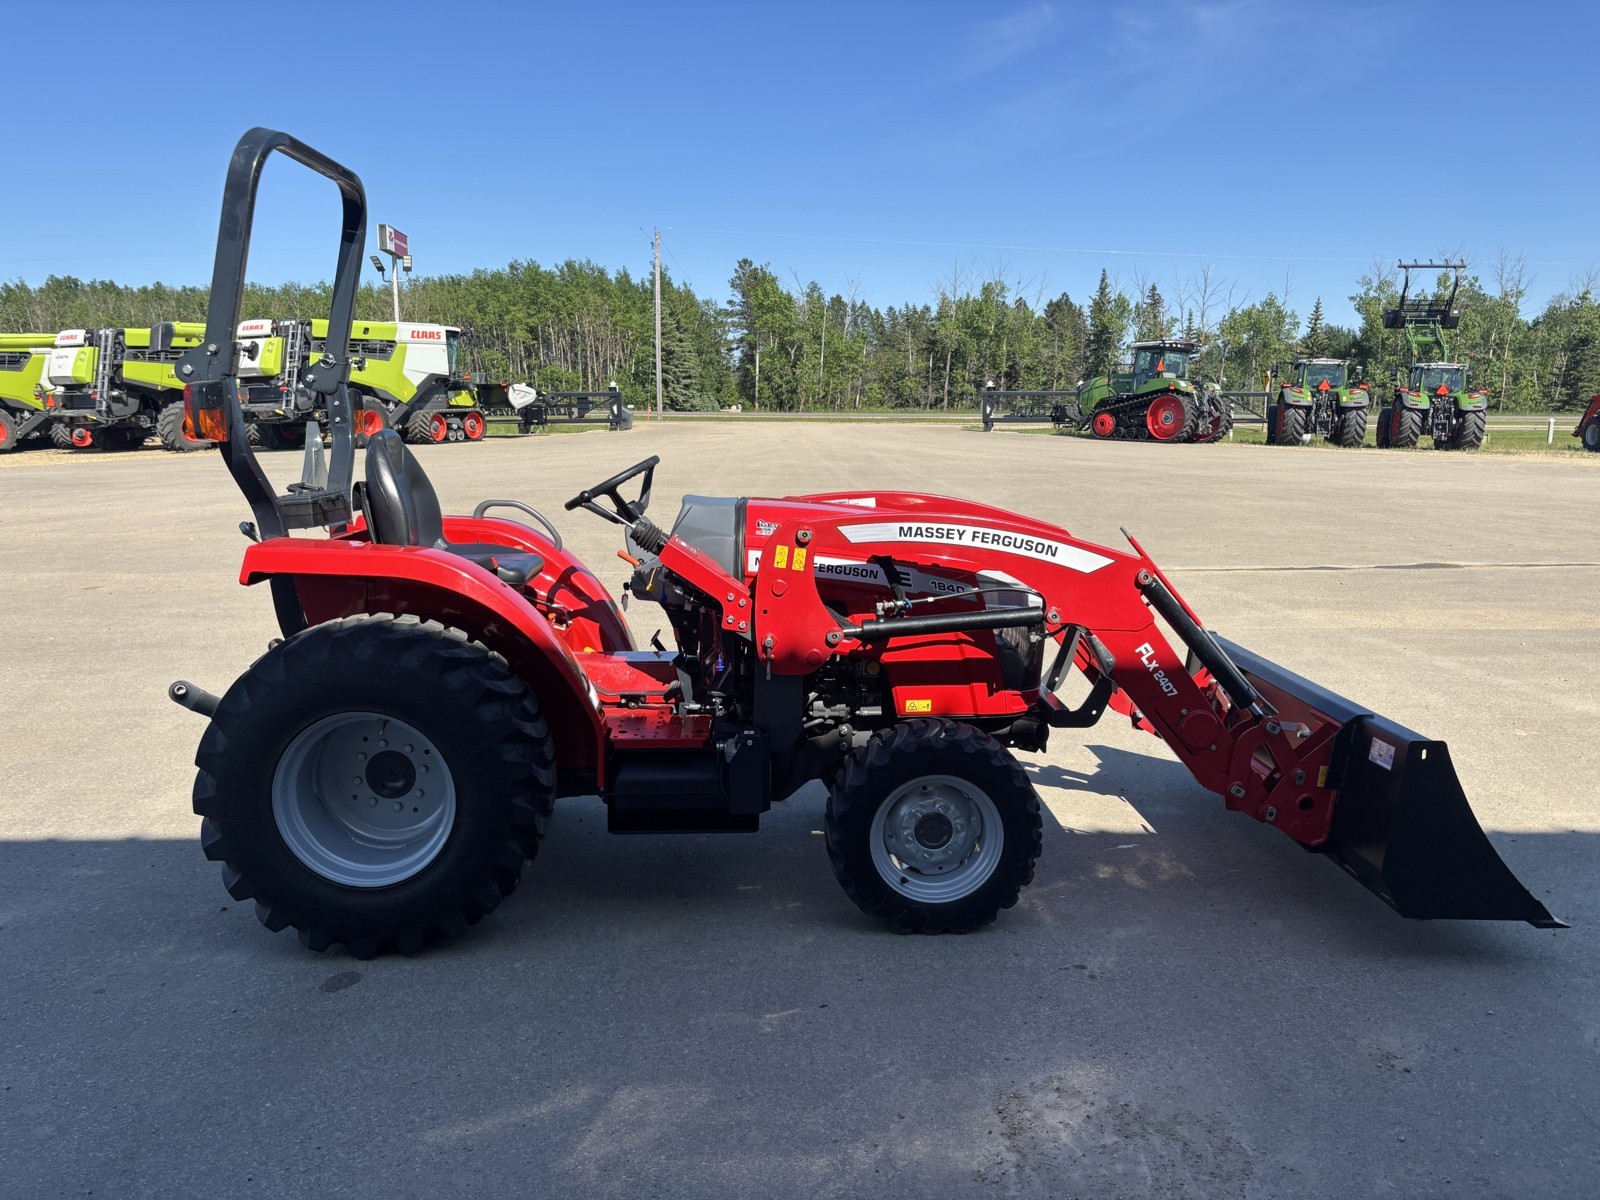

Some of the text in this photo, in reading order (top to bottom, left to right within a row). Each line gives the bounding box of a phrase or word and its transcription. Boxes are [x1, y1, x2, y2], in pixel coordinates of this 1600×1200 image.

[411, 330, 441, 340] CLAAS
[898, 526, 1059, 557] MASSEY FERGUSON
[930, 580, 965, 593] 1840
[1135, 642, 1178, 696] FLX 2407
